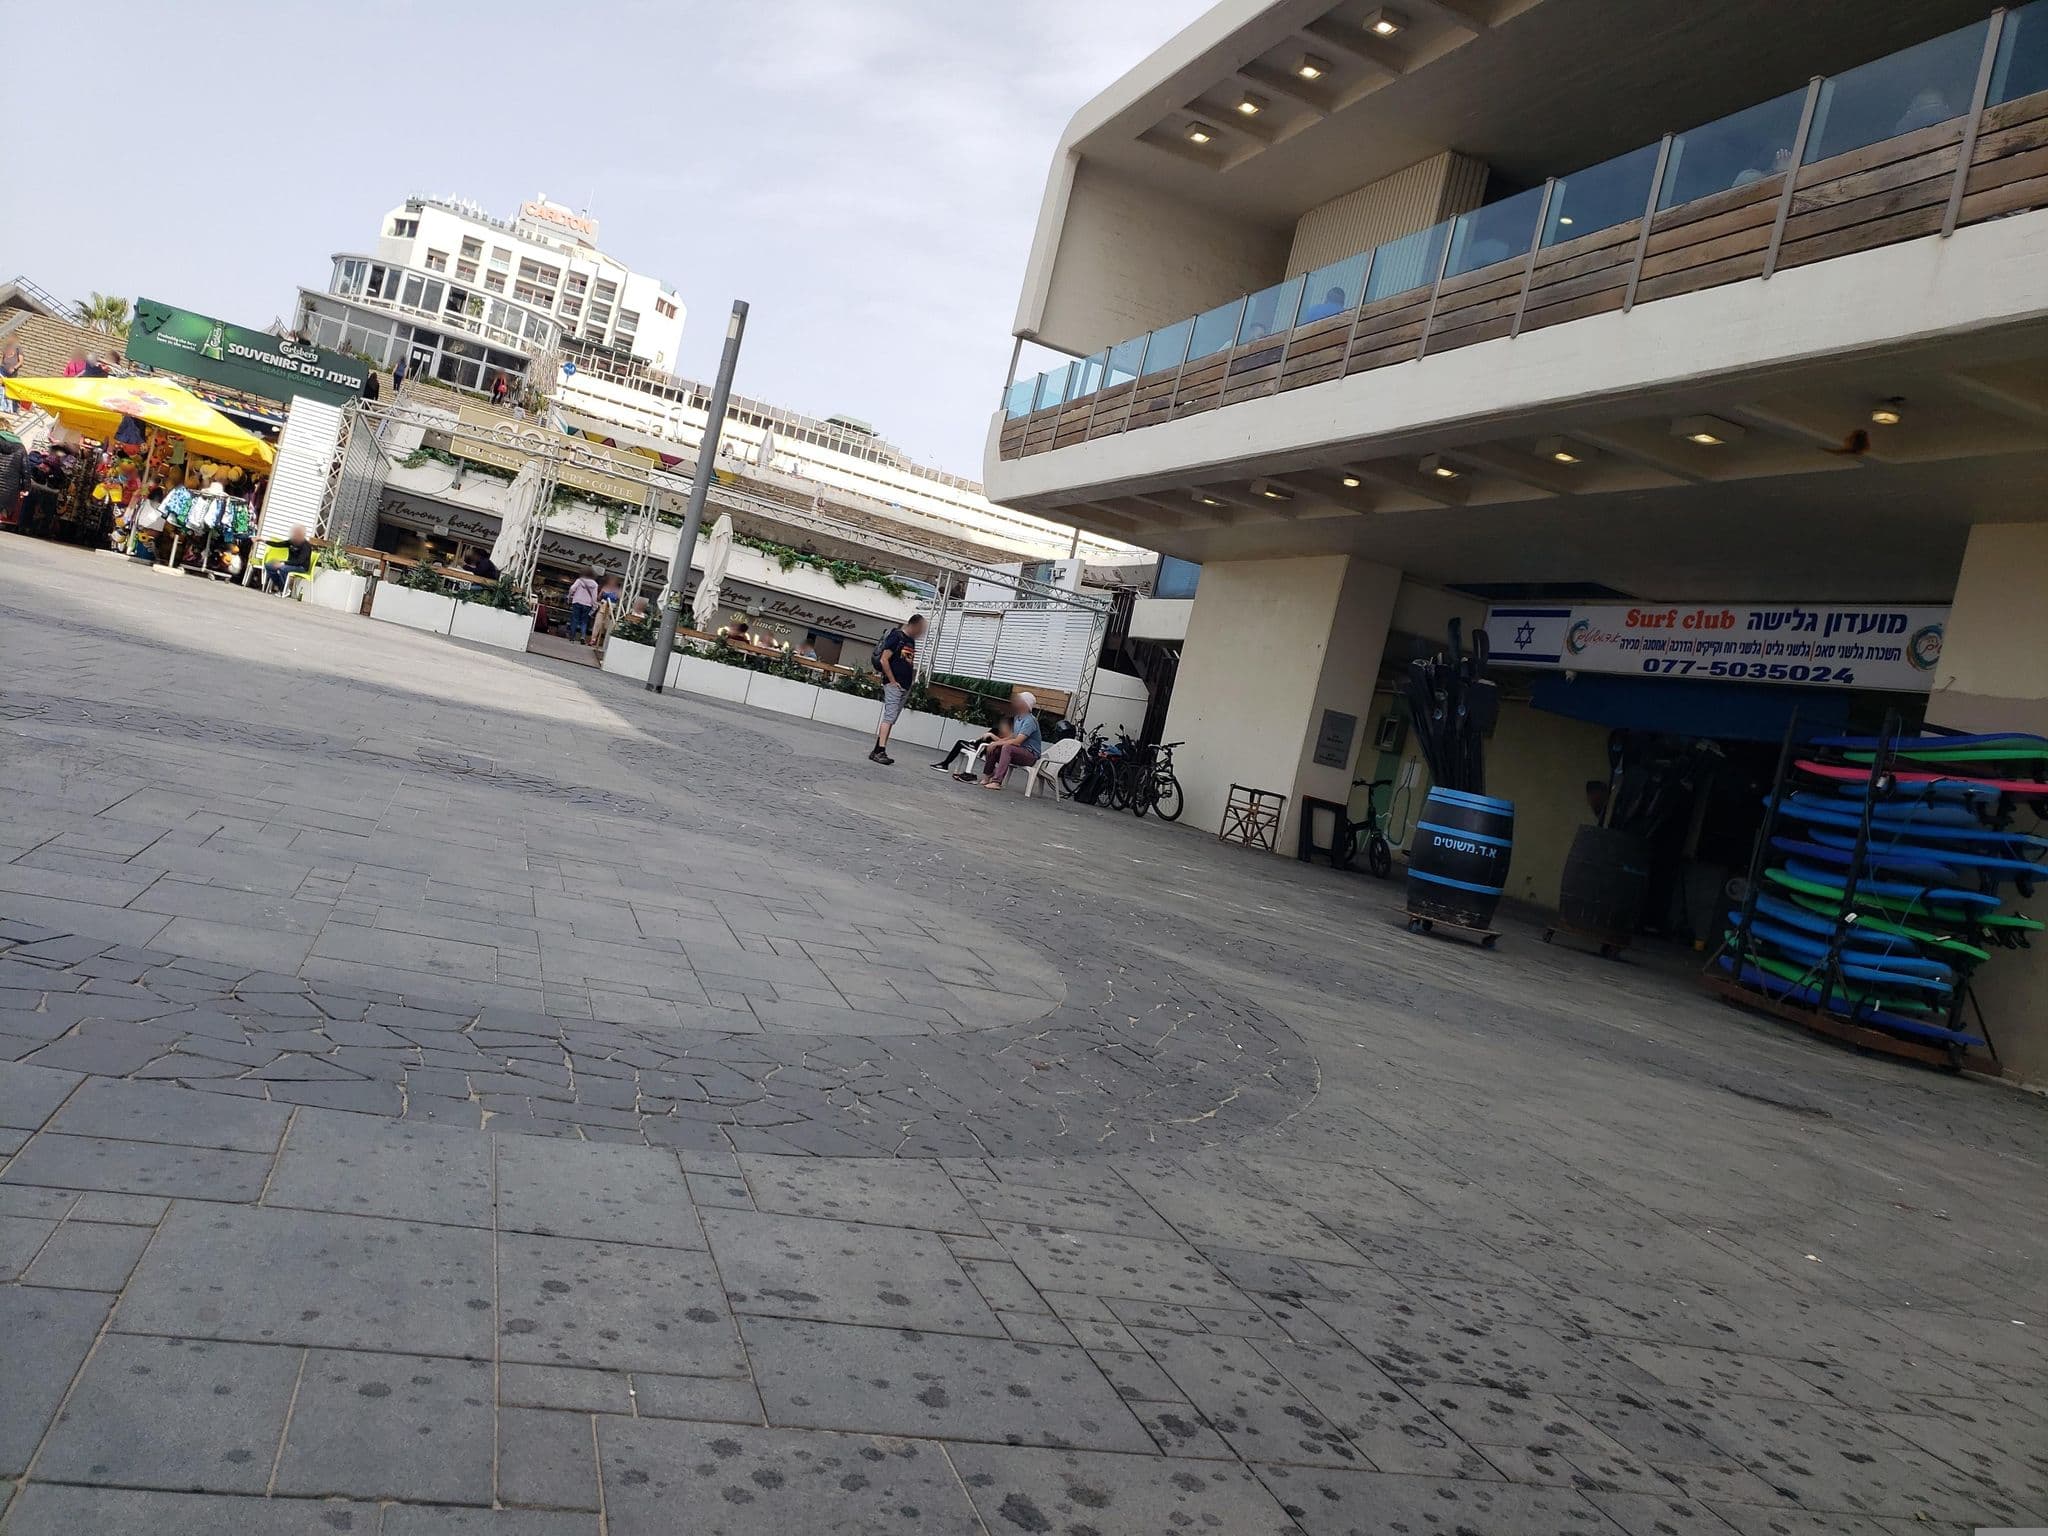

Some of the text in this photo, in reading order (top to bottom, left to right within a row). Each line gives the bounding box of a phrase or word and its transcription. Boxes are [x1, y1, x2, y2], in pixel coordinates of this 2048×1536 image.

[525, 202, 593, 235] CARLTON
[227, 342, 299, 371] SOUVENIRS
[278, 340, 319, 363] Carlsberg
[300, 363, 362, 389] פנינת הים
[488, 452, 526, 468] CREA
[591, 480, 634, 498] COFFEE
[386, 499, 501, 538] Flavour boutiqu
[575, 552, 623, 568] gelato
[768, 600, 857, 630] Italian gelato
[1625, 608, 1736, 629] Surf club
[1746, 608, 1908, 637] מועדון גלישה
[775, 622, 792, 634] For
[1669, 639, 1693, 653] הדרכה
[1738, 639, 1761, 655] גלשני
[1766, 640, 1785, 655] גלים
[1786, 641, 1810, 656] גלשני
[1838, 643, 1863, 659] גלשני
[1865, 644, 1901, 661] השכרת
[1643, 657, 1855, 684] 077-5035024
